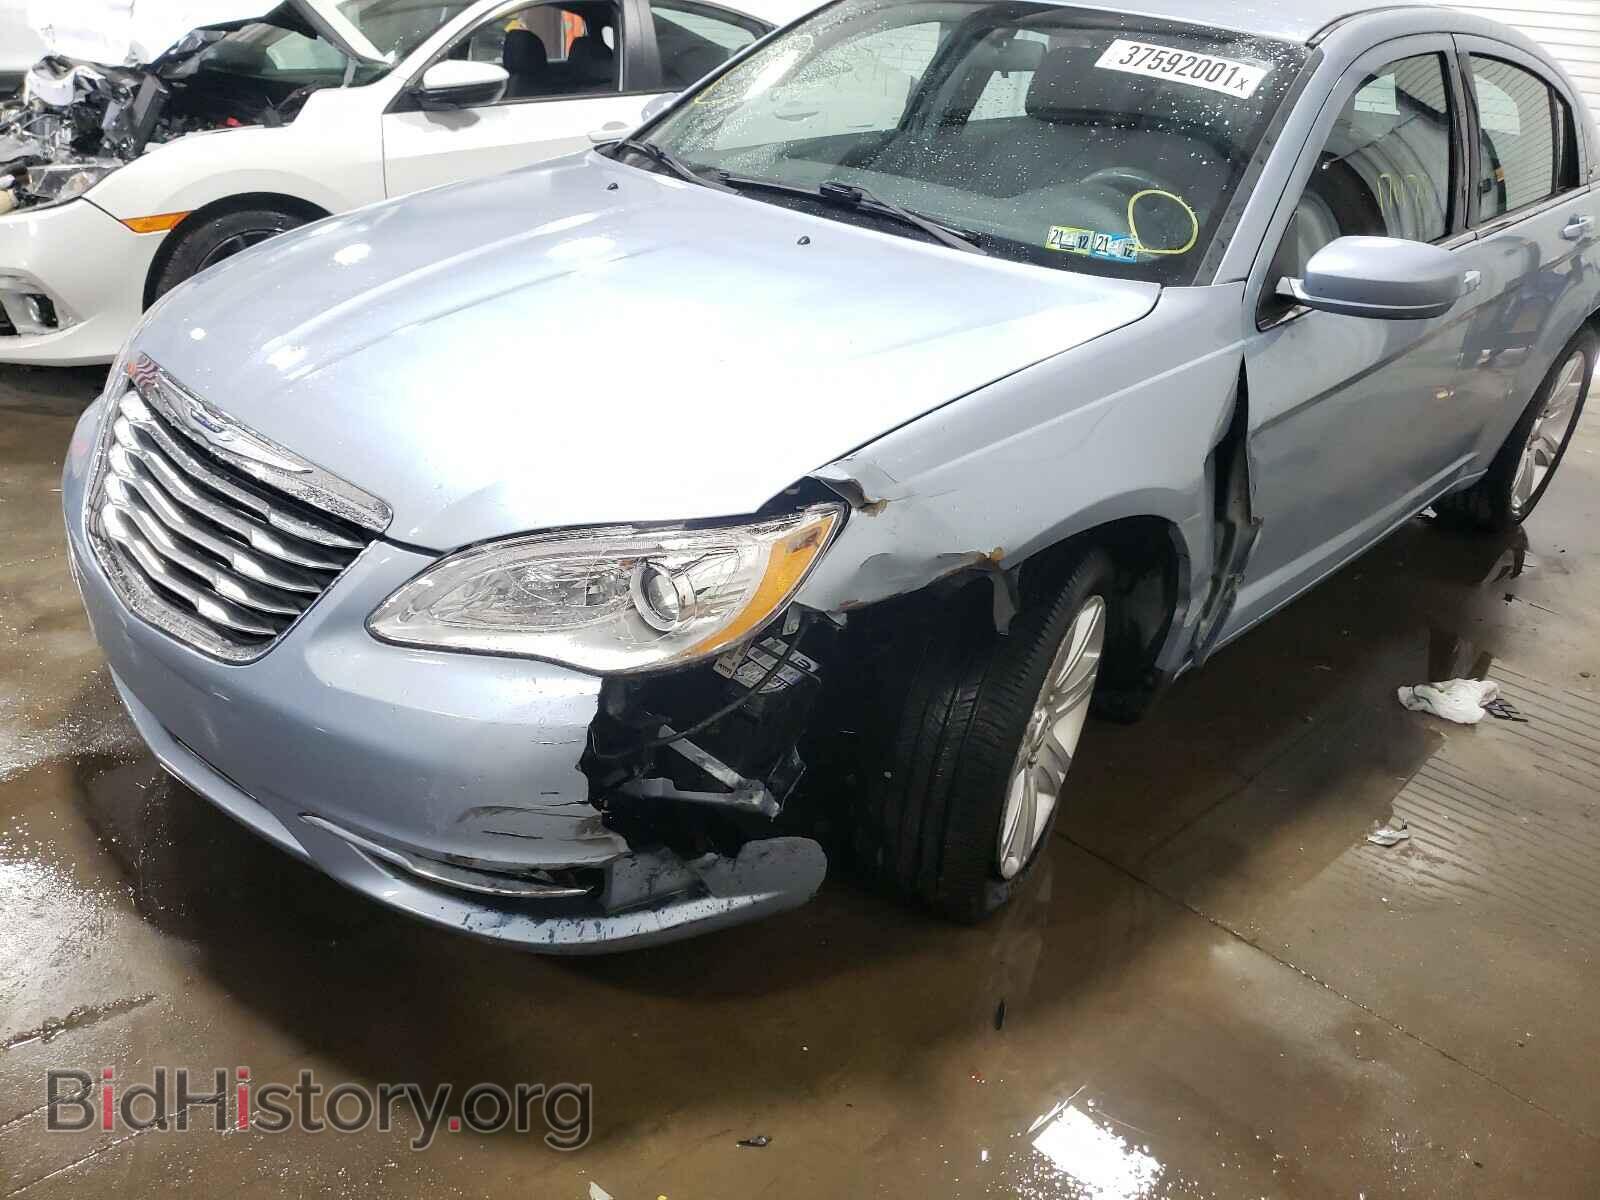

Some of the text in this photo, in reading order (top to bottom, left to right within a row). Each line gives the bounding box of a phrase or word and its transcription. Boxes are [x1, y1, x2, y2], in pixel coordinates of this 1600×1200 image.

[1050, 229, 1089, 249] 21 12
[1096, 235, 1110, 253] 21
